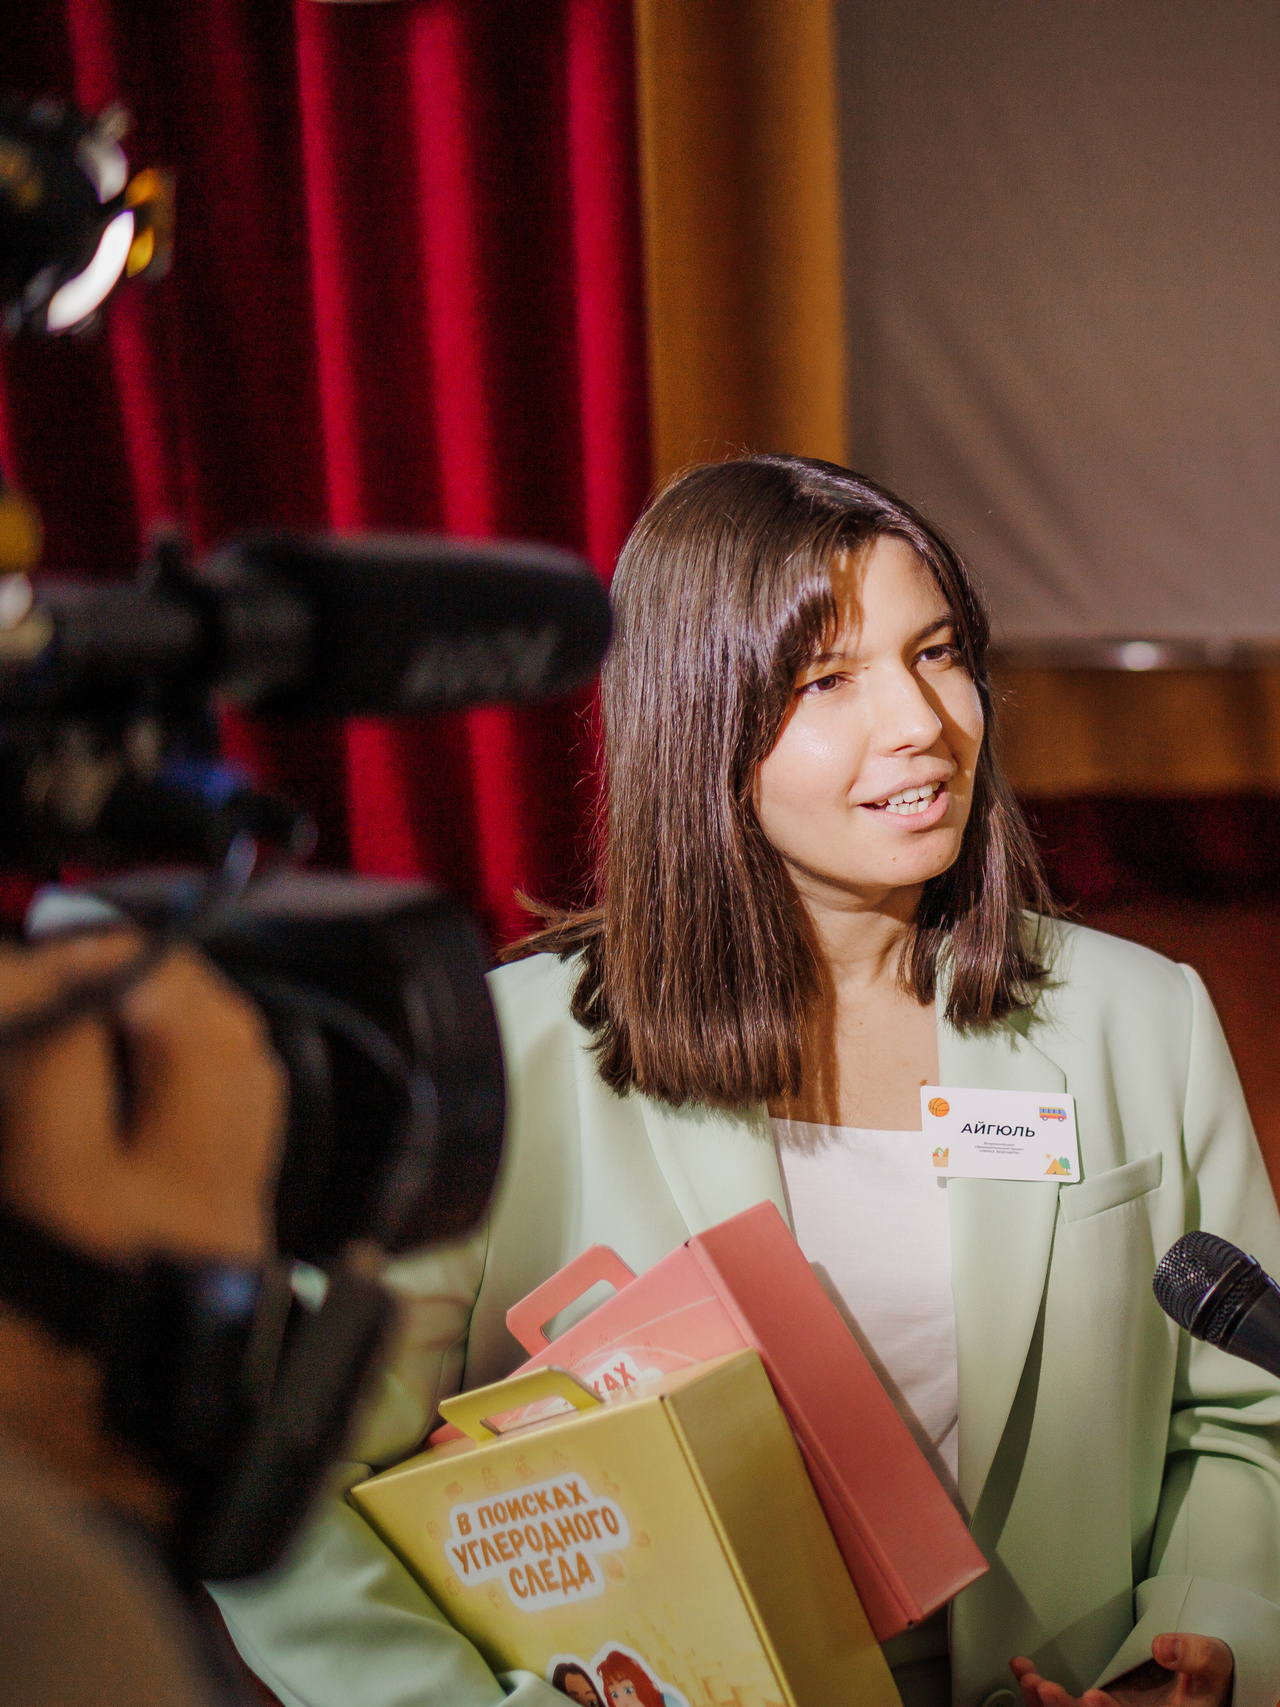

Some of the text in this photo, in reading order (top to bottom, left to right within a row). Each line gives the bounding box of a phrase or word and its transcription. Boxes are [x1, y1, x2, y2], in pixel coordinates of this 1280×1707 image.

[961, 1121, 1036, 1138] АЙГЮЛЬ
[457, 1481, 588, 1536] В ПОИСКАХ
[452, 1506, 620, 1575] УГЛЕРОДНОГО
[509, 1552, 595, 1599] СЛЕДА
